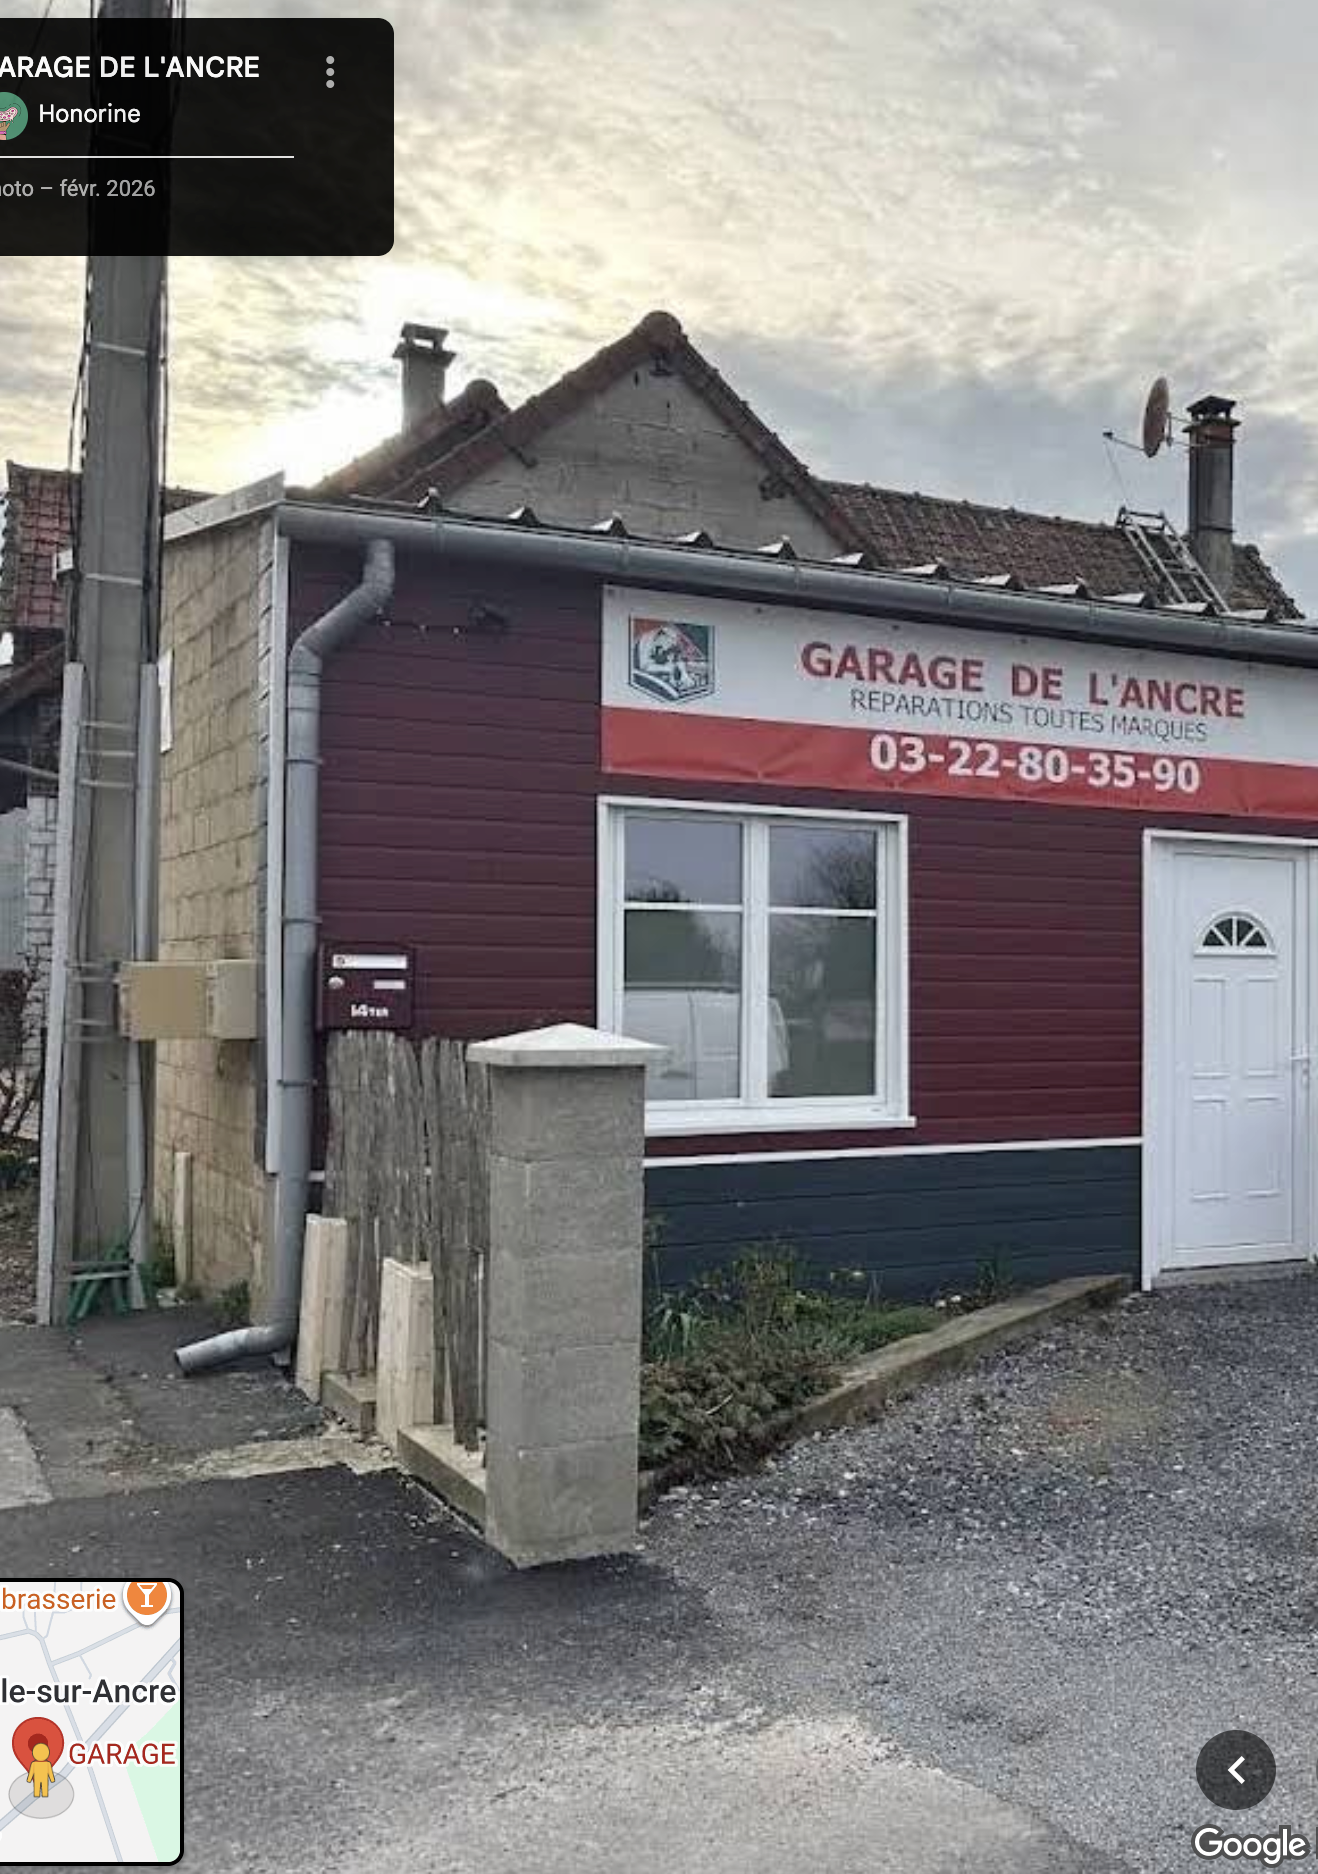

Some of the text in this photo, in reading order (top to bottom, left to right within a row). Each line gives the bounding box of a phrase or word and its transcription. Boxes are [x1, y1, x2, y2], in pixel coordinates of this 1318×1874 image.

[801, 641, 1245, 719] GARAGE DE L'ANCRE
[850, 688, 1208, 743] REPARATIONS TOUTES MARQUES
[869, 733, 1201, 793] 03-22-80-35-90
